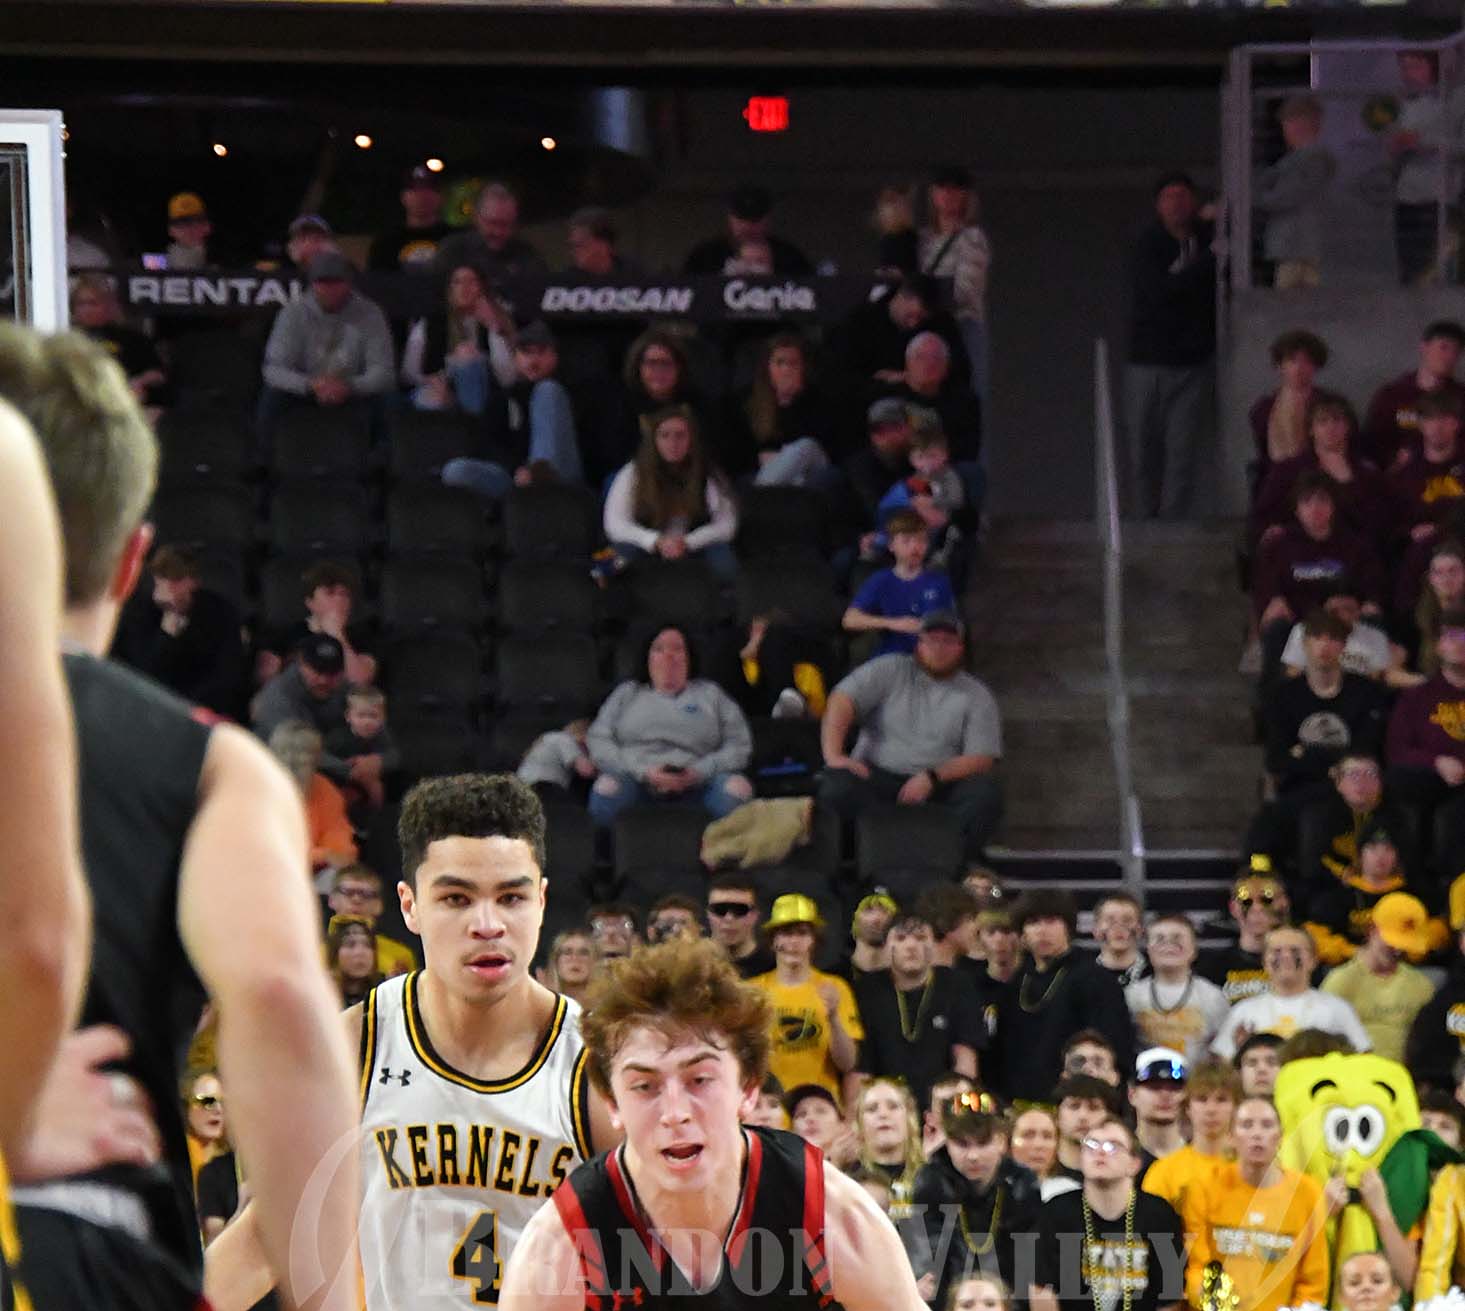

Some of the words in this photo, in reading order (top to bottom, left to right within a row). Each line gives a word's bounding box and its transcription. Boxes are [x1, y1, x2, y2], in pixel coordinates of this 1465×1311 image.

[541, 286, 695, 312] DOOSAN
[723, 279, 817, 311] Genie
[374, 1122, 577, 1198] KERNELS
[448, 1209, 503, 1307] 4
